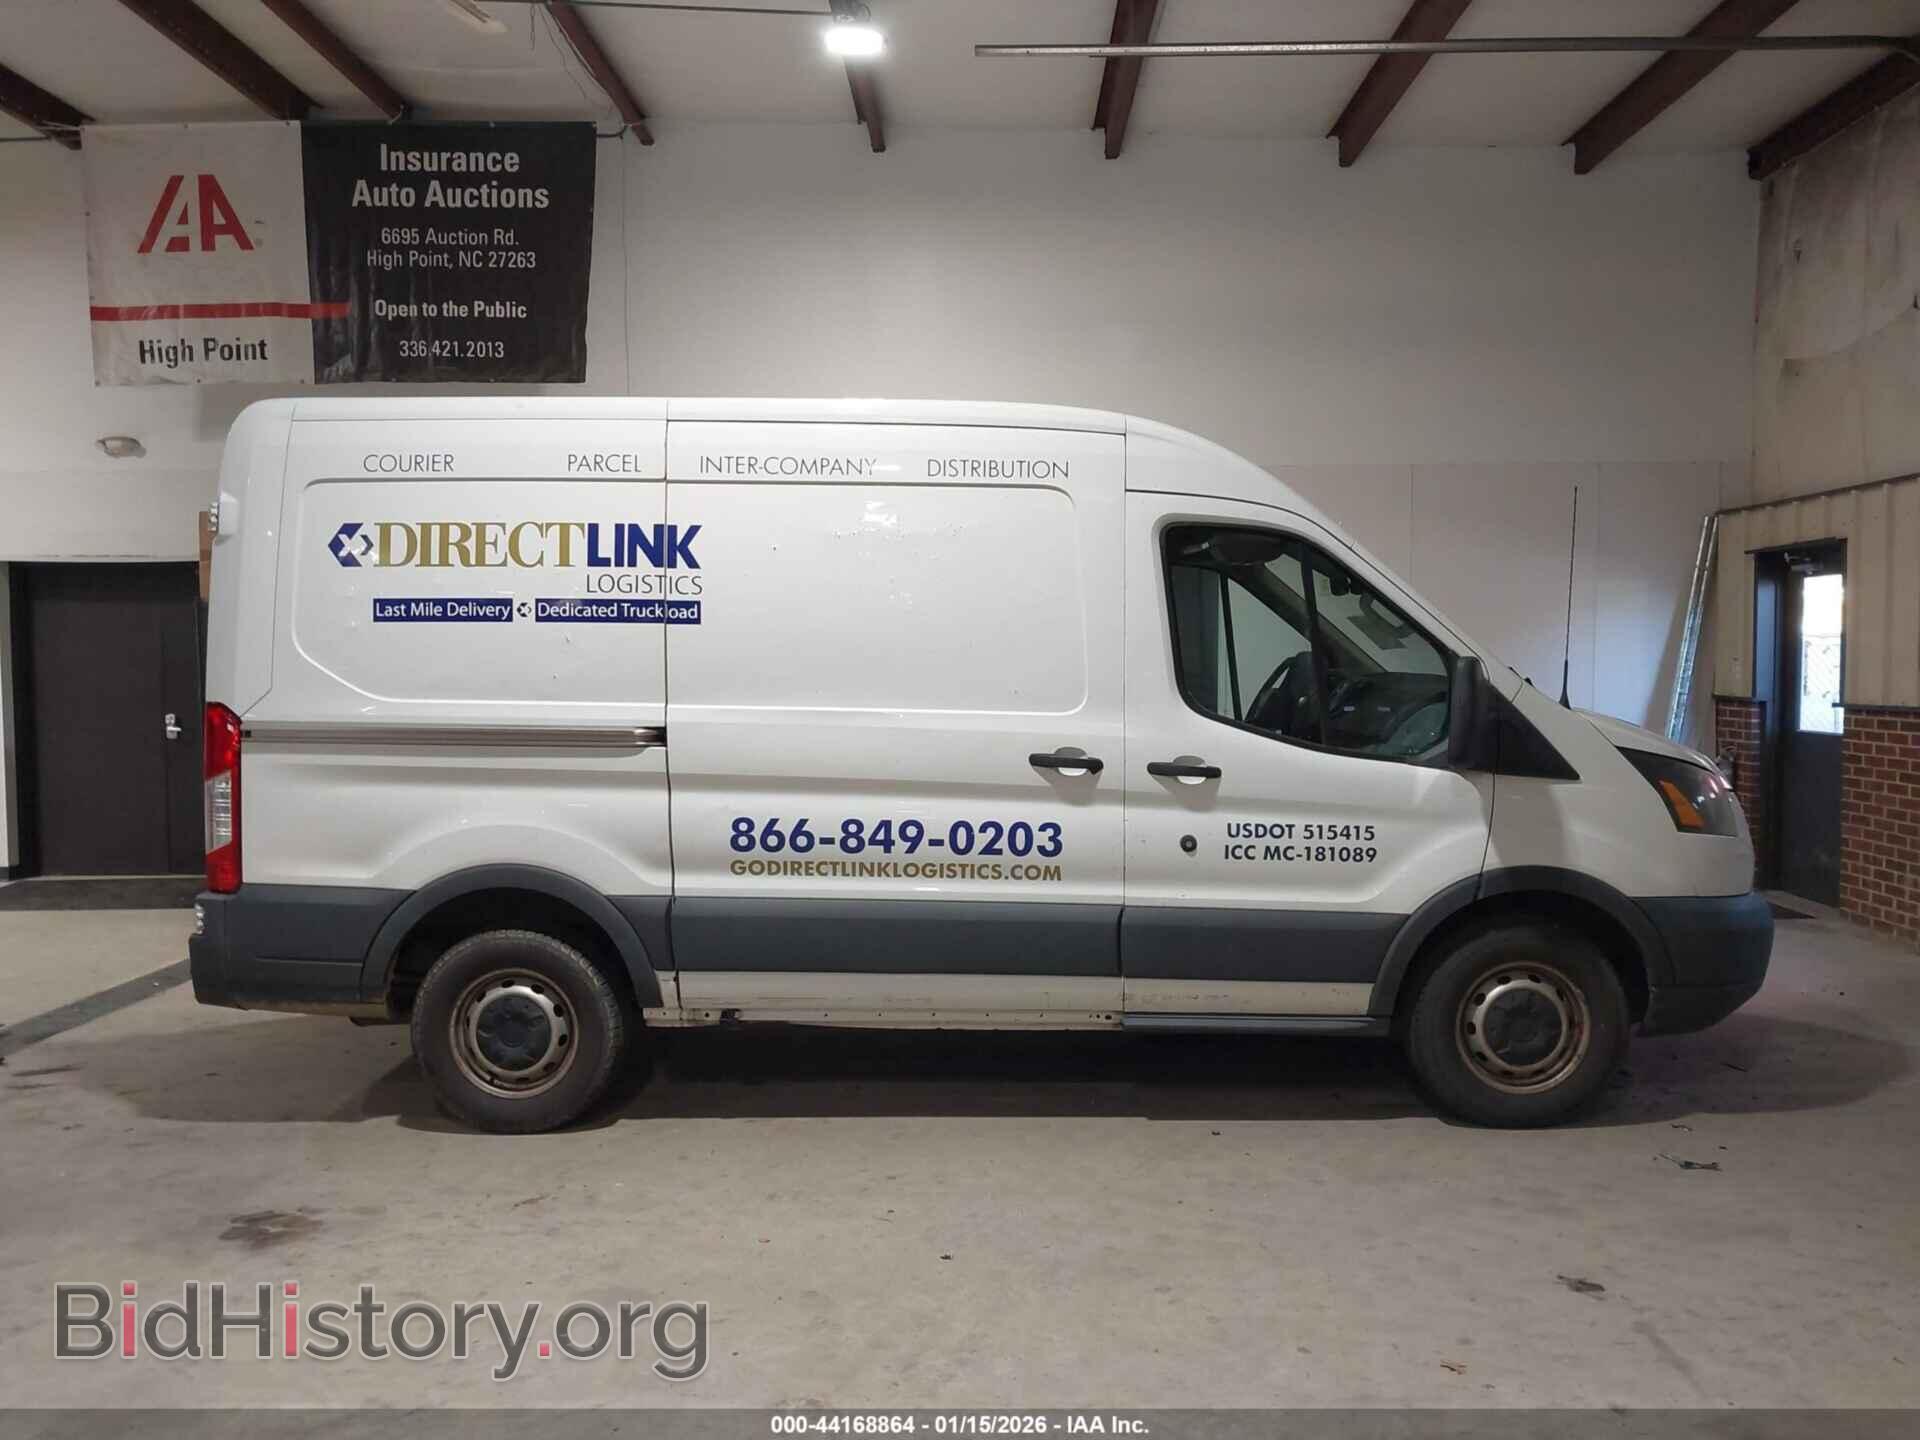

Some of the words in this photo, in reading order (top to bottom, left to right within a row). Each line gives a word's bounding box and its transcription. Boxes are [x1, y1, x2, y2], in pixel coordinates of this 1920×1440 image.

[379, 143, 520, 172] Insurance
[352, 180, 416, 208] Auto
[424, 180, 550, 209] Auctions
[380, 228, 420, 247] 6695
[425, 227, 489, 247] Auction
[494, 227, 519, 246] Rd.
[366, 249, 403, 271] High
[408, 250, 455, 270] Point,
[458, 250, 484, 269] NC
[487, 250, 537, 269] 27263
[374, 300, 419, 320] Open
[422, 301, 440, 318] to
[443, 300, 469, 318] the
[473, 300, 528, 320] Public
[138, 338, 195, 369] High
[203, 336, 269, 361] Point
[399, 340, 505, 359] 336.421.2013
[363, 453, 455, 474] COURIER
[567, 453, 642, 474] PARCEL
[700, 455, 877, 477] INTER-COMPANY
[927, 458, 1070, 478] DISTRIBUTION
[586, 573, 704, 597] LOGISTICS
[375, 602, 407, 618] Last
[410, 602, 444, 618] Mile
[446, 601, 511, 621] Delivery
[538, 603, 618, 618] Dedicated
[729, 816, 1064, 858] 866-849-0203
[1226, 822, 1296, 840] USDOT
[1302, 823, 1376, 841] 515415
[1223, 844, 1257, 861] ICC
[1263, 845, 1378, 863] MC-181089
[729, 859, 1063, 882] GODIRECTLINKLOGISTICS.COM
